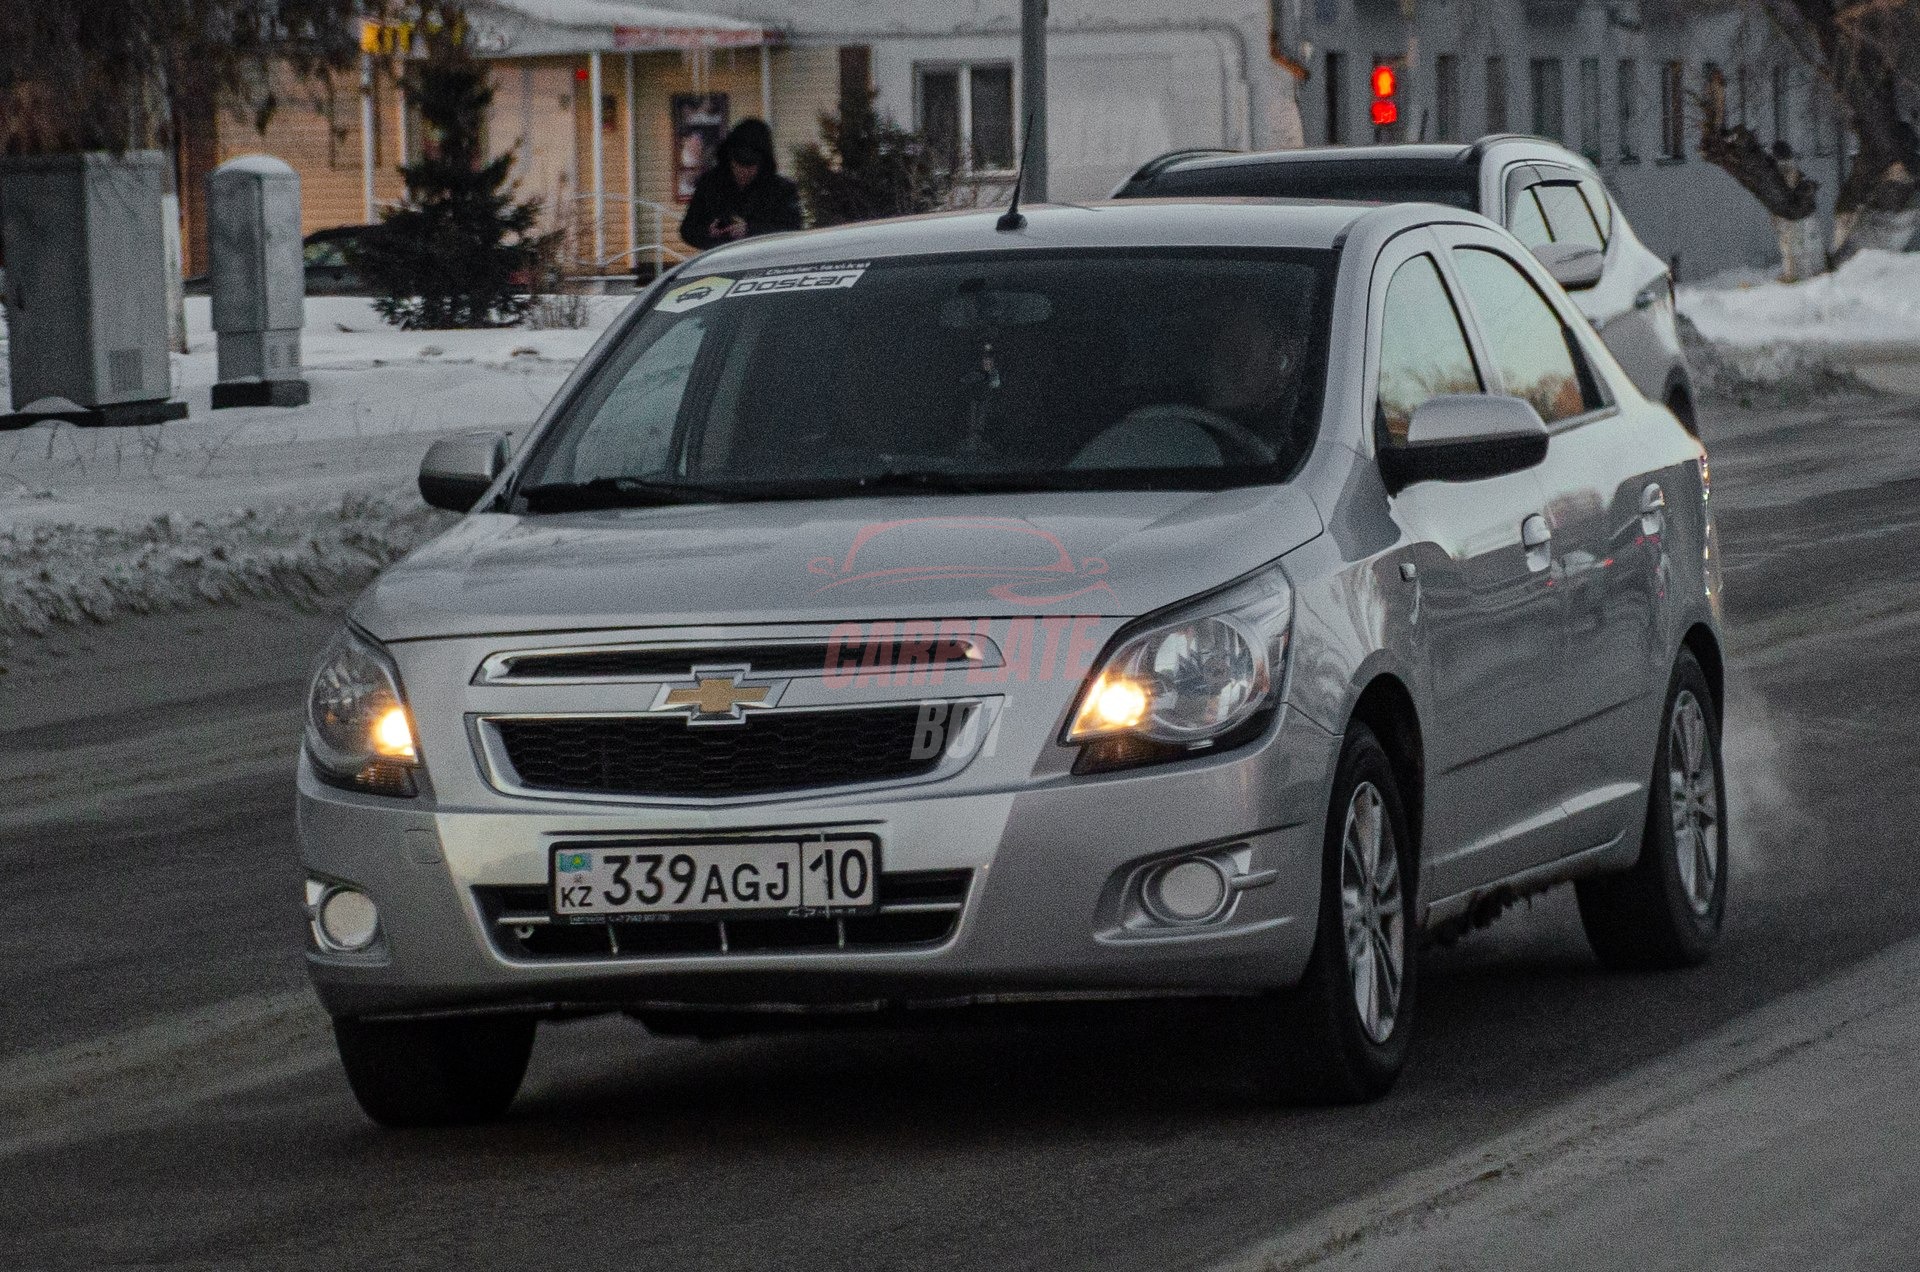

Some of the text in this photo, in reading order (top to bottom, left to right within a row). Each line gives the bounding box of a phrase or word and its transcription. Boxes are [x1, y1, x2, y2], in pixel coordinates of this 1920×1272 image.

[733, 273, 858, 294] Dostar
[808, 847, 868, 901] 10
[561, 886, 593, 908] KZ
